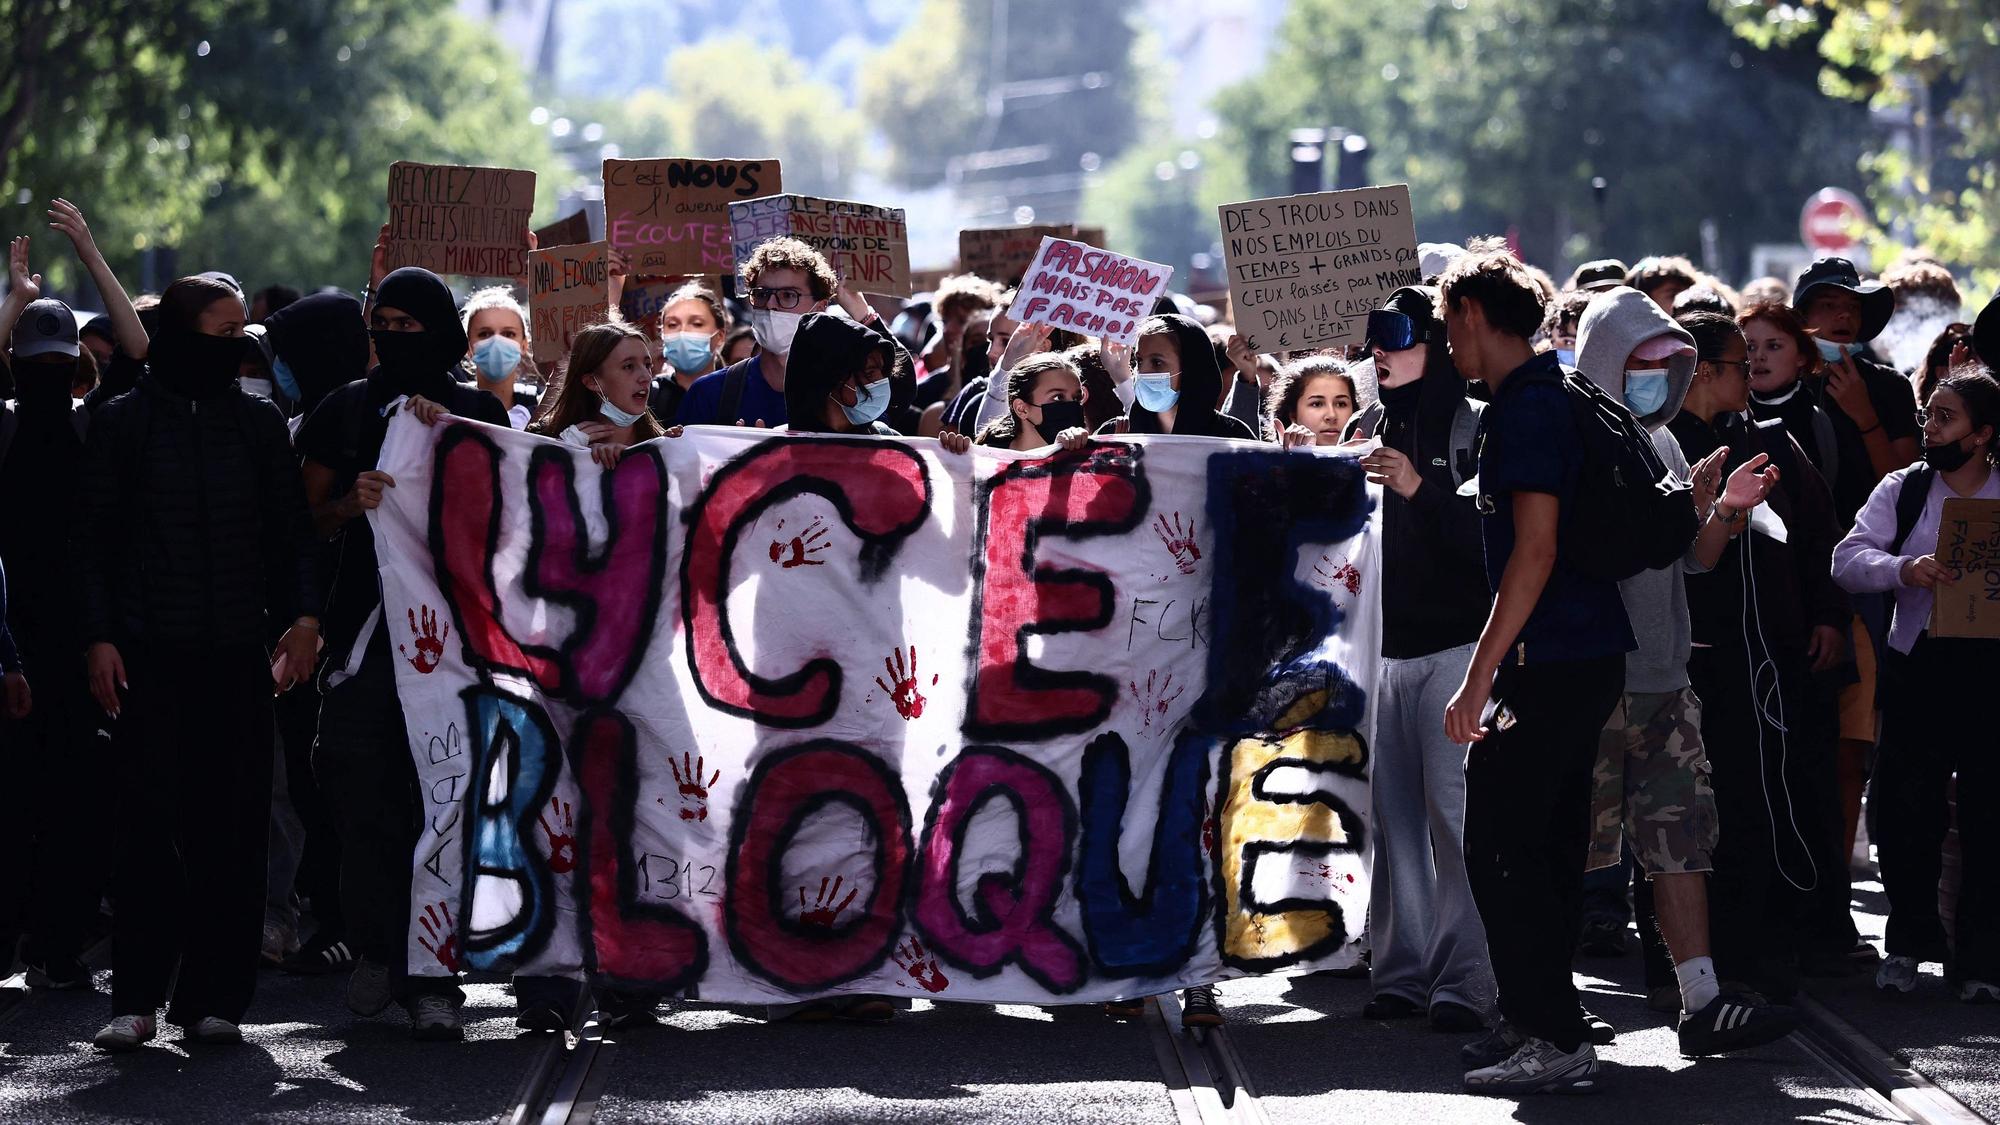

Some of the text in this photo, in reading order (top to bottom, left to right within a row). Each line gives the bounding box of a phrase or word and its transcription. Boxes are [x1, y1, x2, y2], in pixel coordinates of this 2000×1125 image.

[483, 170, 511, 206] VOS
[668, 160, 762, 196] NOUS
[825, 201, 874, 218] POUR
[1225, 199, 1399, 233] DES TROUS DANS
[864, 237, 890, 251] DE
[1231, 228, 1381, 258] NOS EMPLOIS DU
[535, 262, 559, 295] MAL
[1235, 260, 1300, 281] TEMPS
[1333, 248, 1392, 270] GRANDS
[1095, 287, 1144, 317] PAS
[1241, 289, 1283, 307] CEUX
[1348, 276, 1372, 294] par
[1023, 297, 1135, 340] FACHO!
[1263, 297, 1381, 331] DANS LA CAISSE
[1967, 540, 1987, 573] PAS
[1127, 596, 1208, 651] FCK
[424, 721, 466, 886] ACAB
[638, 853, 718, 899] 1312
